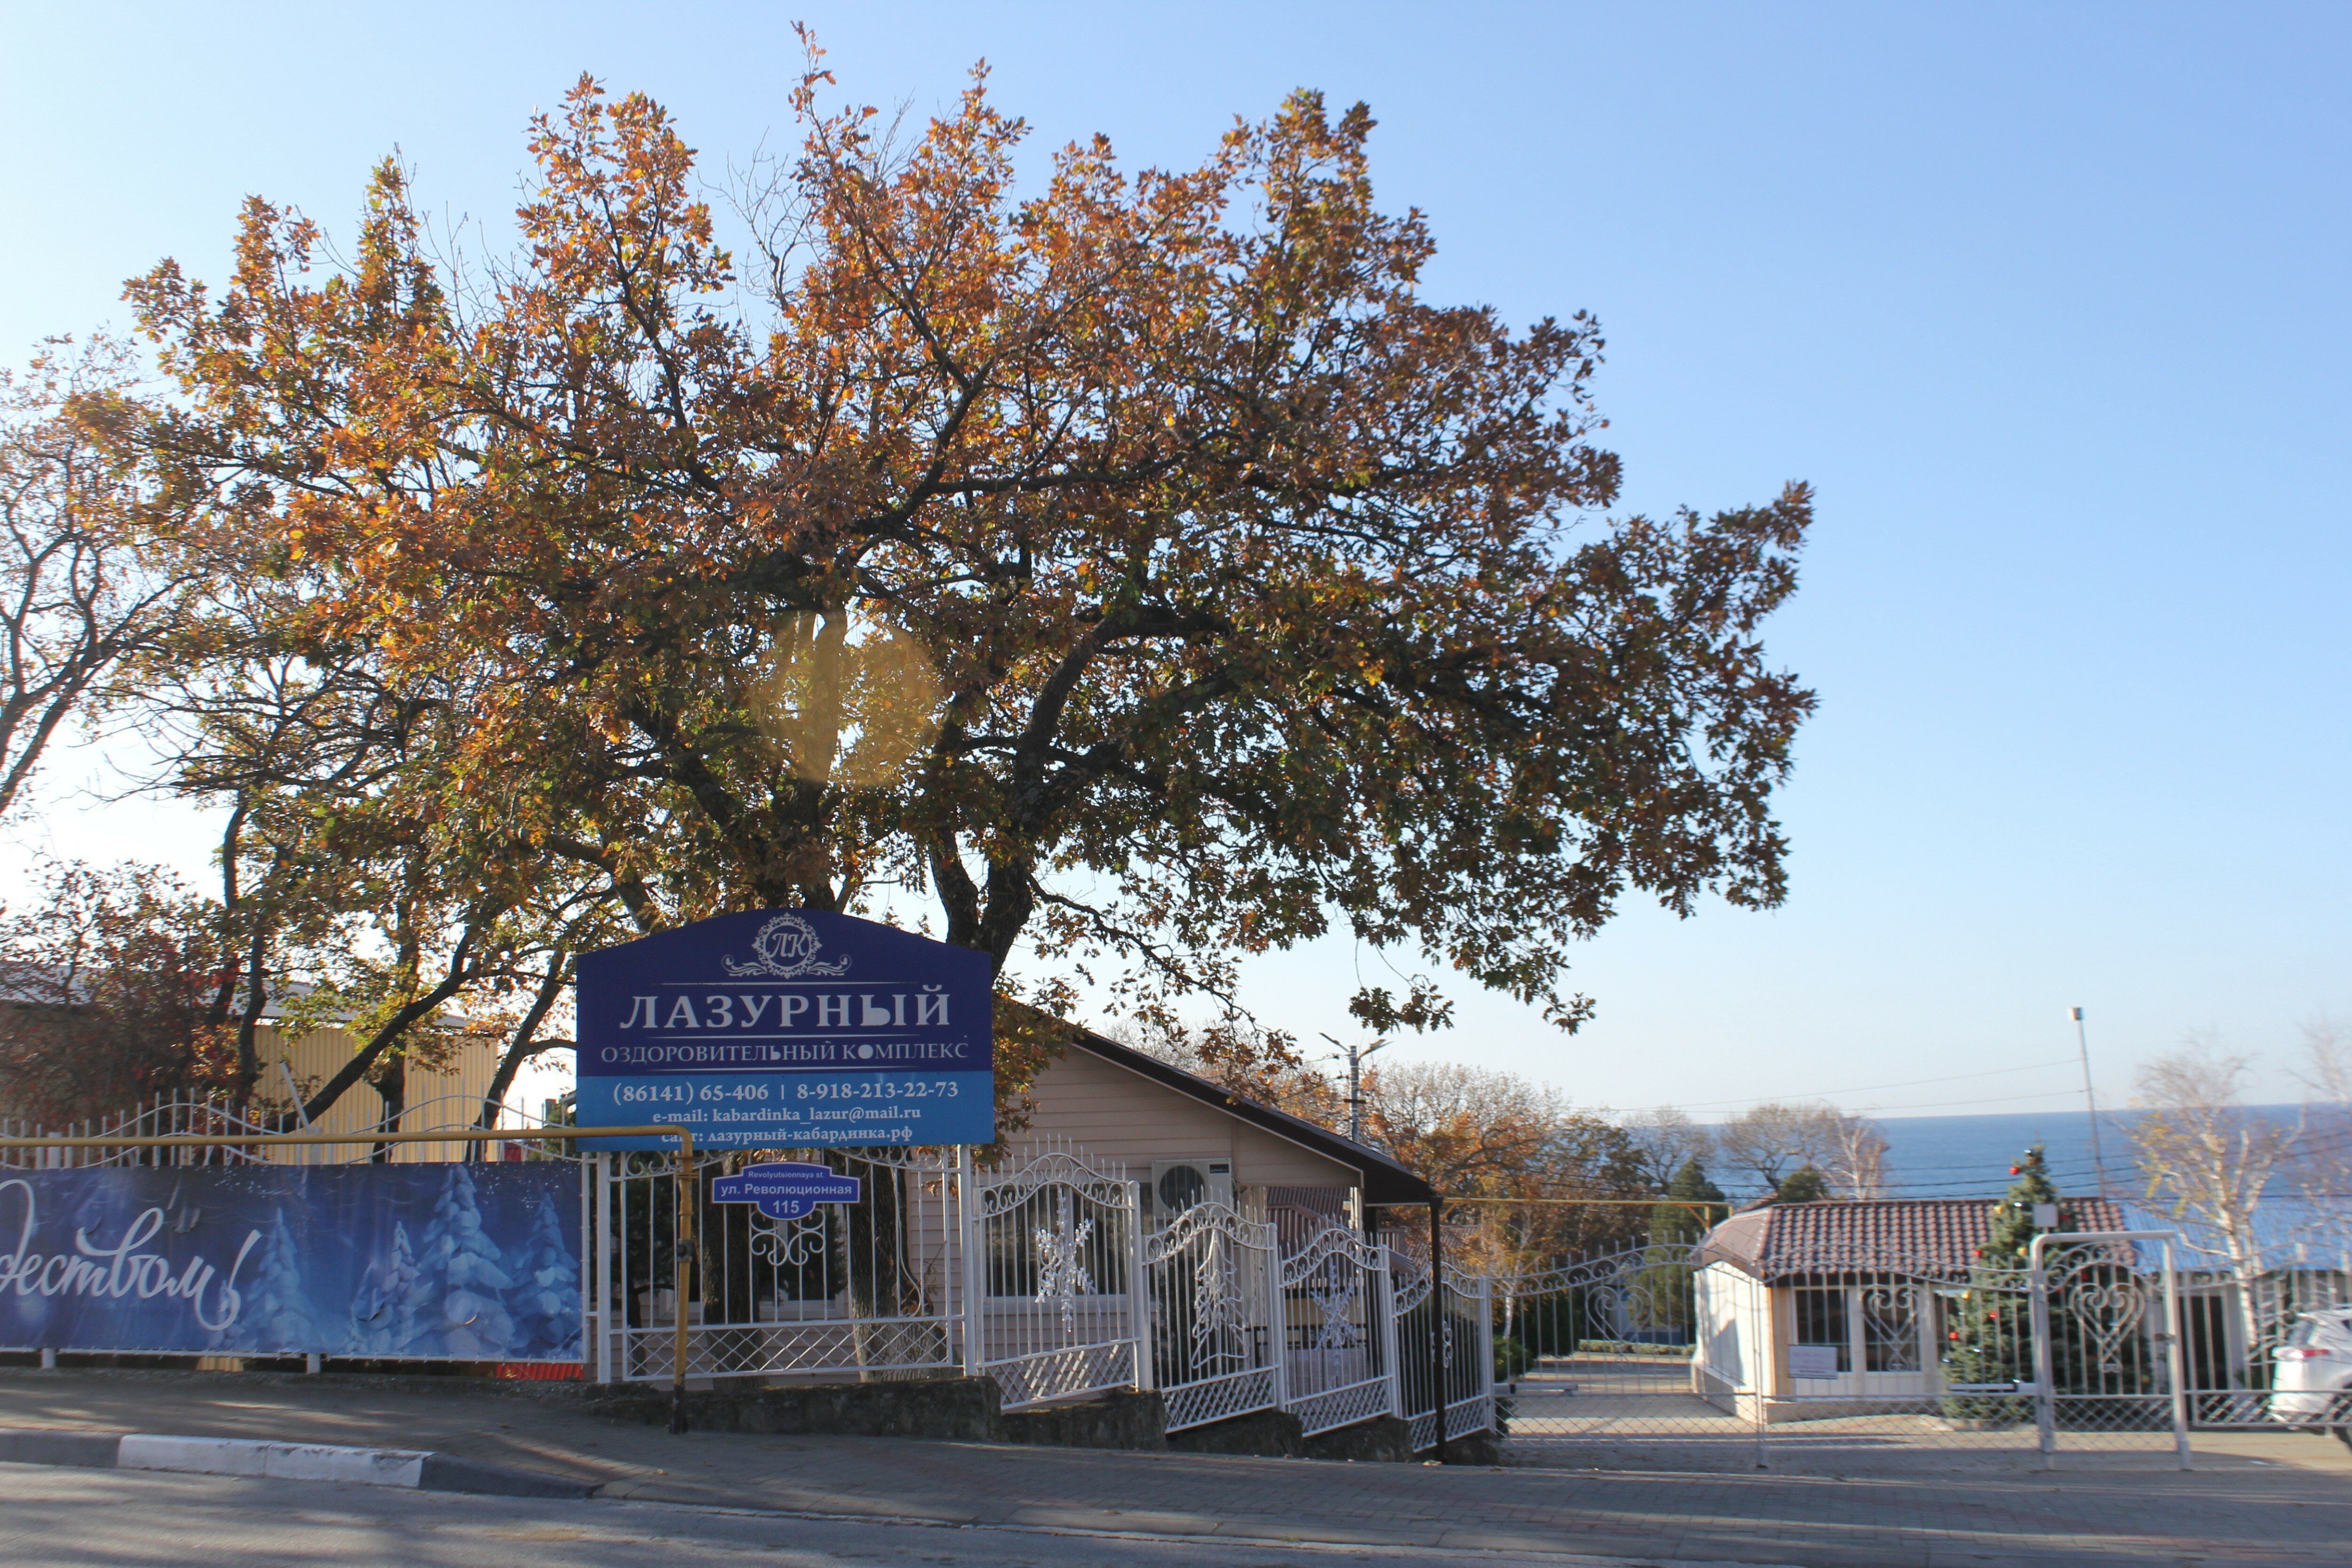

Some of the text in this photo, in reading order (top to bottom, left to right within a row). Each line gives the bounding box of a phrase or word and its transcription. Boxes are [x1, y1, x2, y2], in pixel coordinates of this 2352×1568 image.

[768, 932, 808, 958] ЛК
[619, 984, 950, 1029] ЛАЗУРНЫЙ
[601, 1041, 969, 1065] ОЗДОРОВИТЕЛЬНЫЙ КОМПЛЕКС
[613, 1081, 959, 1106] (86141) 65-406 8-918-213-22-73
[652, 1106, 921, 1124] e-mail: kabardinka_lazur@mail.ru
[661, 1126, 913, 1145] сат: лазурный-кабардинка.рф
[748, 1170, 814, 1179] Revolyutsionnaya
[721, 1184, 852, 1197] ул. Революционная
[772, 1200, 799, 1214] 115
